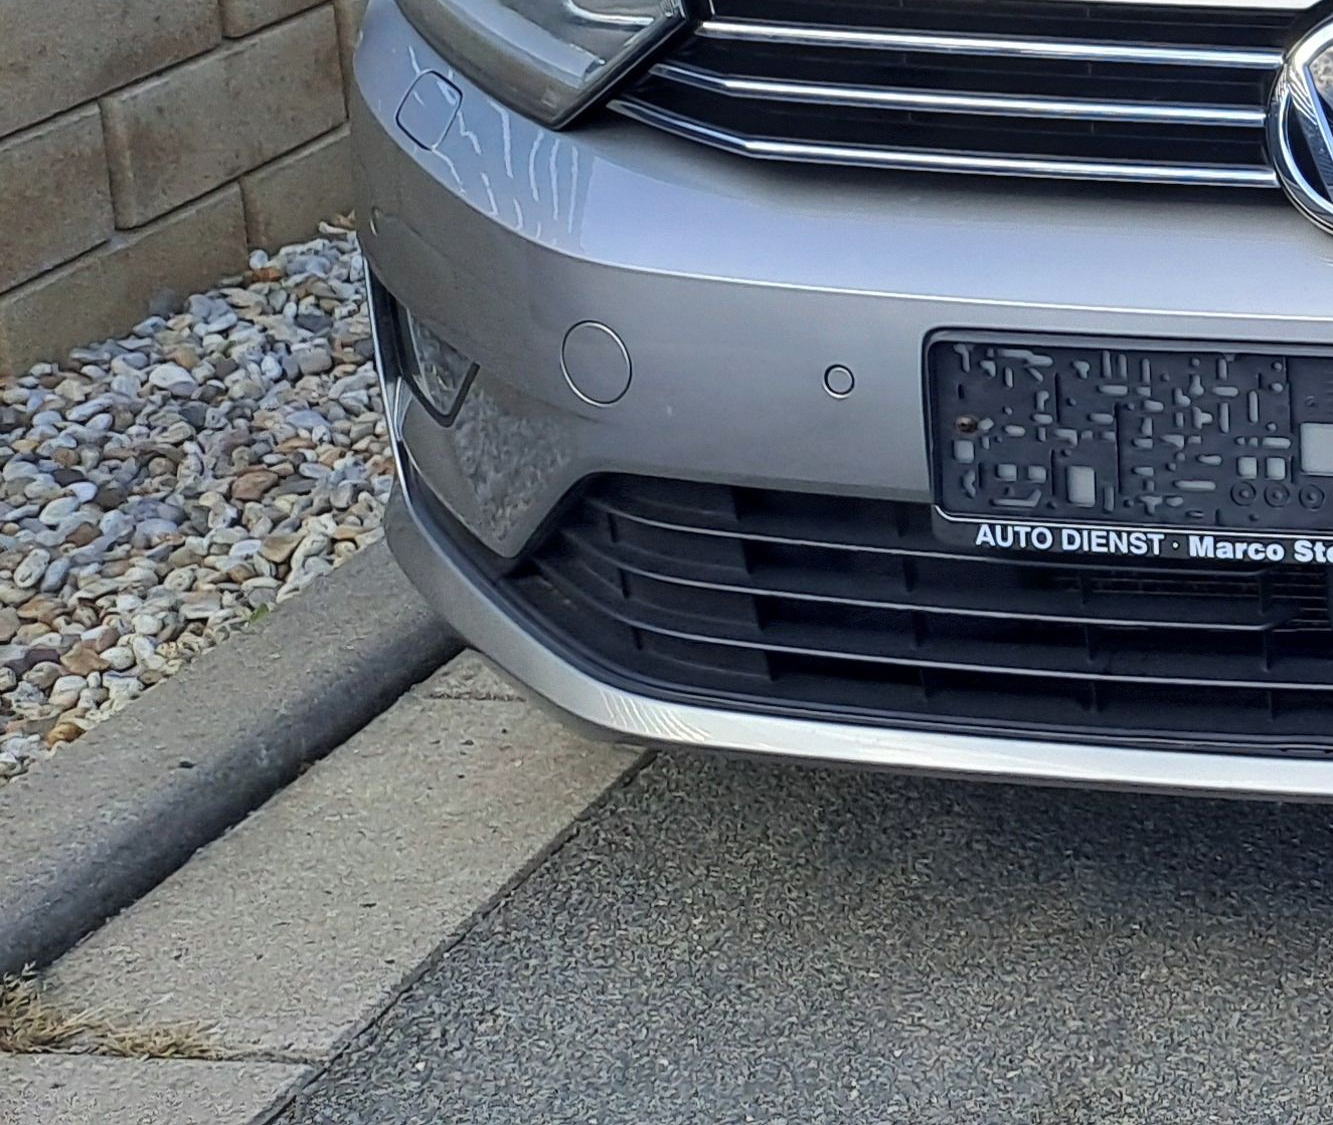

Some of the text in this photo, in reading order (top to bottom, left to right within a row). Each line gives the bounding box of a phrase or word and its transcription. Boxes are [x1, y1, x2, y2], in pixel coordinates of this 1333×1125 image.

[975, 524, 1053, 550] AUTO
[1061, 528, 1165, 556] DIENST
[1188, 535, 1285, 561] Marco
